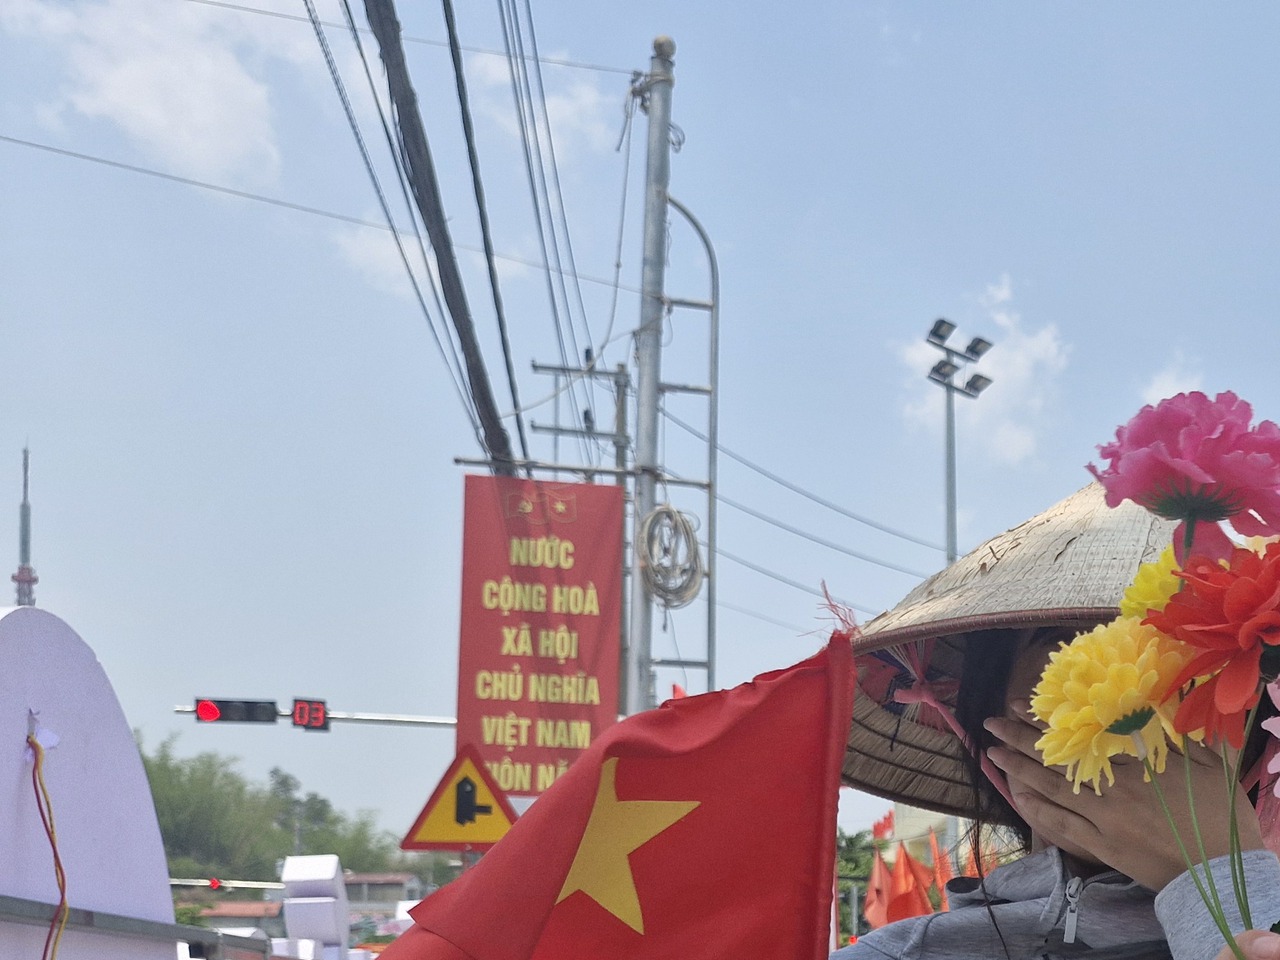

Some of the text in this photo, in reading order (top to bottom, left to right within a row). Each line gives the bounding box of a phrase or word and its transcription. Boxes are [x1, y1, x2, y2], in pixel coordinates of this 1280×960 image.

[510, 535, 575, 570] NƯỚC
[482, 576, 600, 616] CỘNG HOÀ
[500, 622, 578, 664] XÃ HỘI
[475, 663, 600, 705] CHỦ NGHĨA
[295, 702, 324, 727] 03
[482, 711, 591, 752] VIỆT NAM
